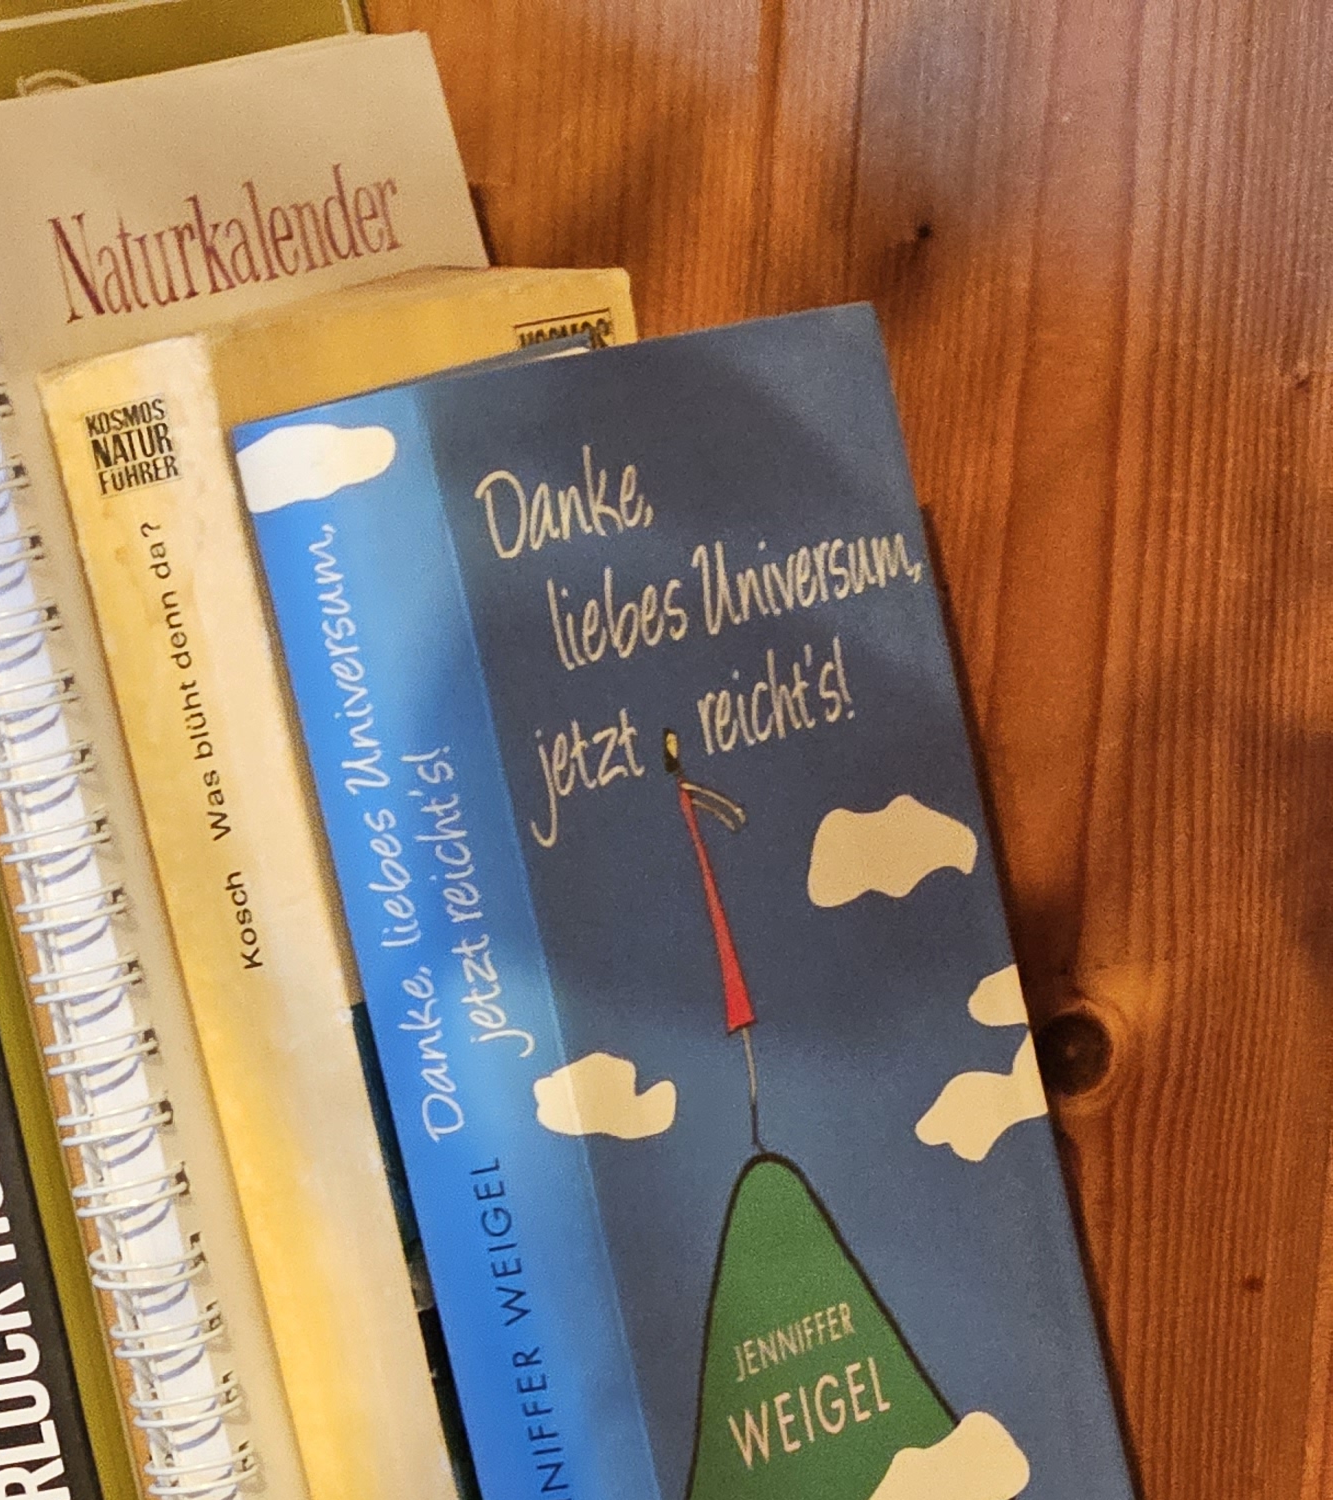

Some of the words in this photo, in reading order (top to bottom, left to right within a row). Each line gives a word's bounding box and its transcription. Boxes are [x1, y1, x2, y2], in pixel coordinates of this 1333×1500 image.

[47, 162, 404, 325] Naturkalender
[85, 399, 166, 436] KOSMOS
[90, 424, 174, 472] NATUR
[98, 455, 179, 497] FÜHRER
[474, 444, 654, 560] Danke,
[140, 522, 172, 580] da?
[547, 566, 689, 671] liebes
[690, 532, 923, 636] Universum,
[161, 589, 192, 670] denn
[309, 523, 391, 797] Universum,
[179, 681, 215, 761] blüht
[531, 707, 645, 849] jetzt
[696, 635, 857, 756] reicht's!
[208, 771, 233, 841] Was
[401, 745, 485, 925] reicht's!
[224, 871, 263, 971] Kosch
[368, 806, 425, 951] liebes
[398, 963, 465, 1143] Danke,
[448, 932, 535, 1060] jetzt
[470, 1157, 532, 1328] WEIGEL
[733, 1301, 857, 1384] JENNIFFER
[728, 1356, 892, 1471] WEIGEL
